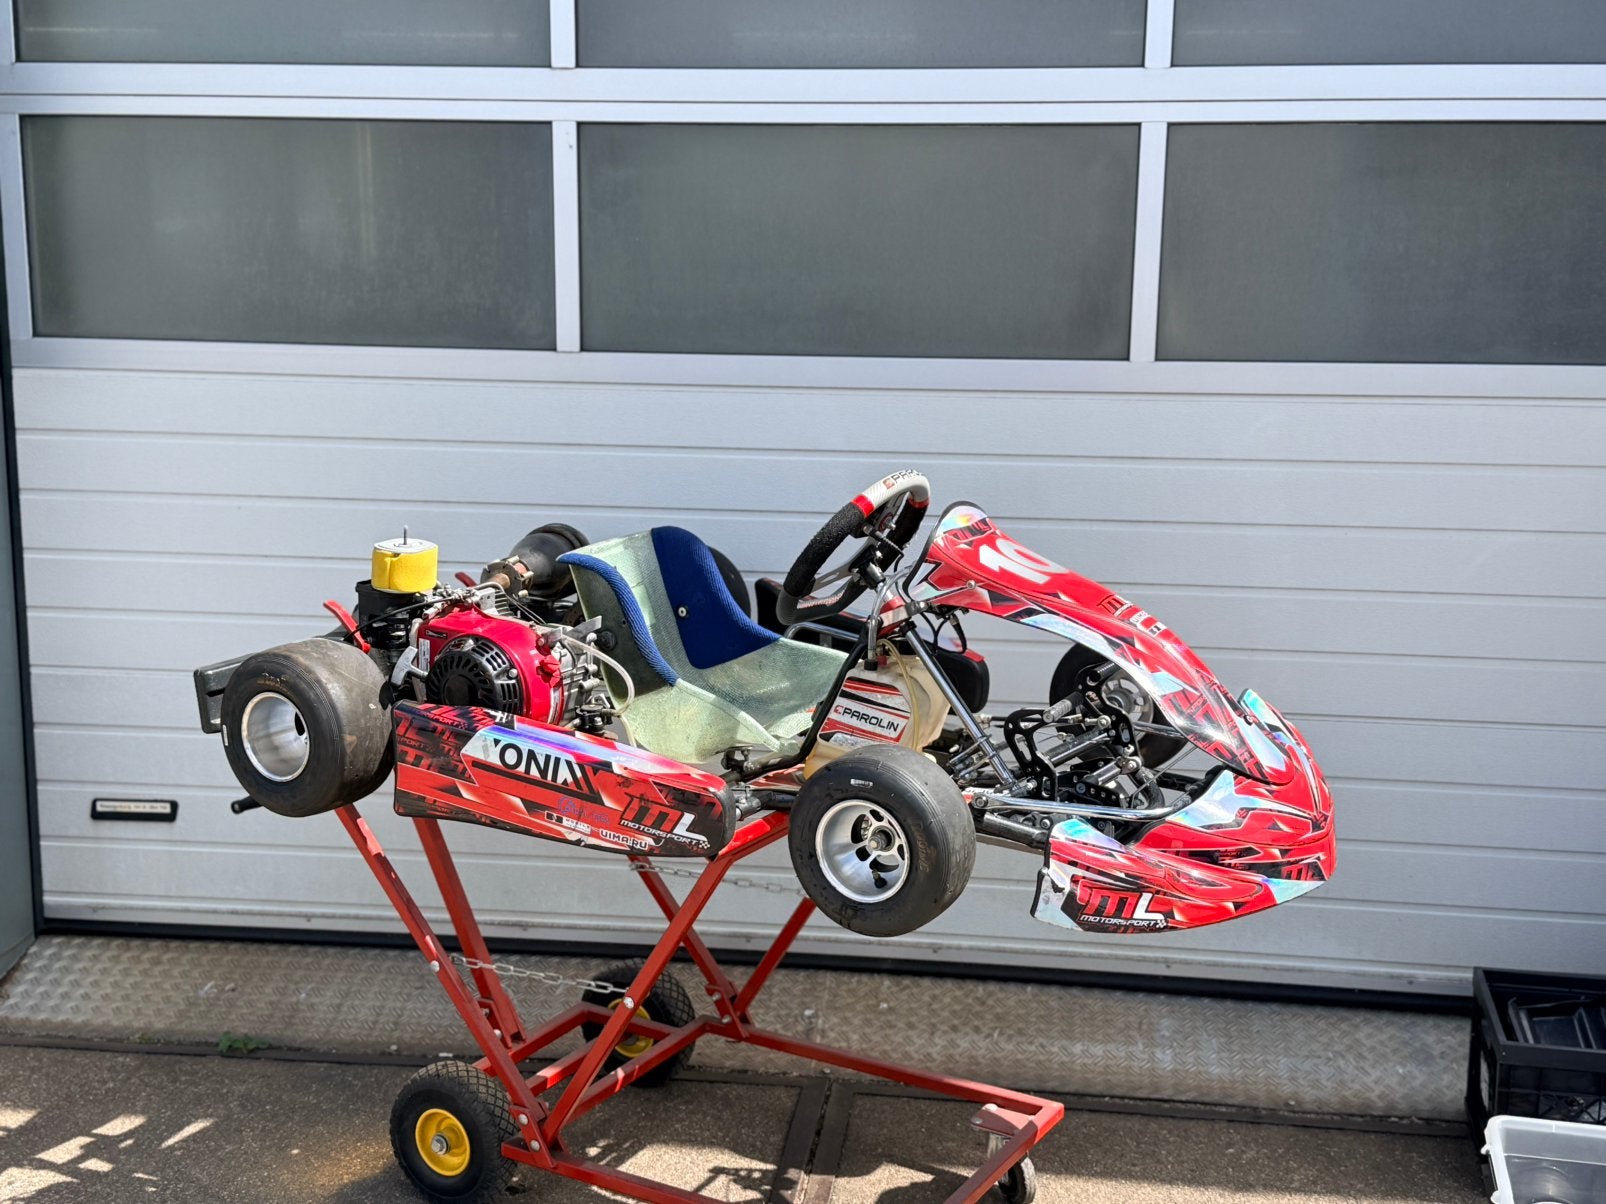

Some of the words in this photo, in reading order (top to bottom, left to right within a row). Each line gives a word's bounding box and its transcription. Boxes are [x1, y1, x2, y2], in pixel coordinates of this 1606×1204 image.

[978, 538, 1071, 585] 10
[841, 707, 900, 732] PAROLIN
[619, 819, 699, 846] MOTORSPORT
[621, 796, 709, 843] ML
[1083, 888, 1165, 920] ML
[1080, 914, 1157, 927] MOTORSPORT
